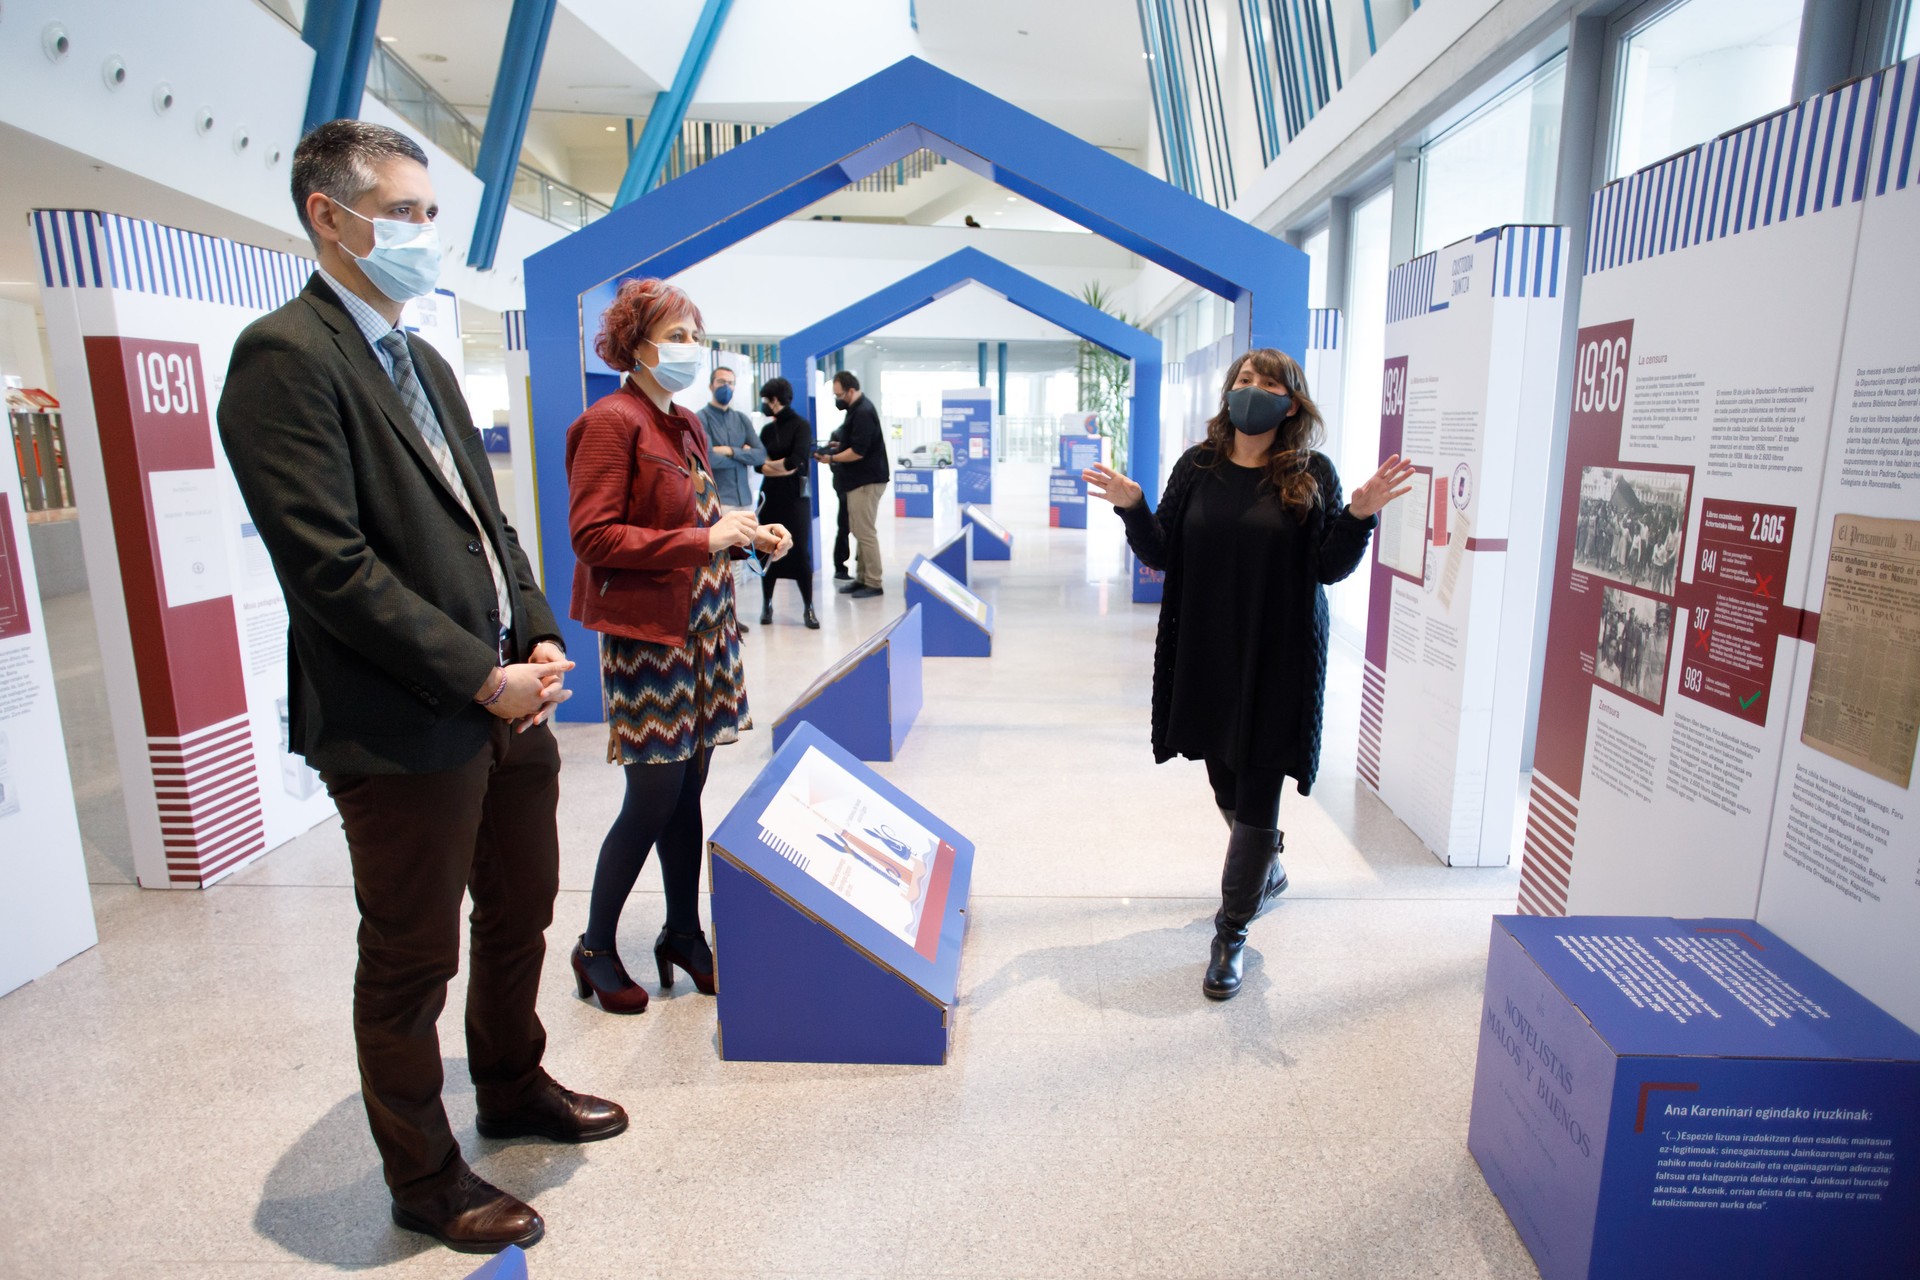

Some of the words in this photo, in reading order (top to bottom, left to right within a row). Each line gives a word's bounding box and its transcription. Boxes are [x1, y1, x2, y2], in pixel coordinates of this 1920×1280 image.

[1638, 356, 1644, 365] La
[1646, 355, 1667, 364] censura
[1575, 337, 1626, 412] 1936
[136, 352, 199, 414] 1931
[1860, 379, 1885, 387] Diputación
[1886, 377, 1907, 386] encargó
[1382, 366, 1404, 416] 1934
[1852, 400, 1857, 408] de
[1873, 399, 1896, 407] Biblioteca
[1892, 414, 1912, 423] bajaban
[1894, 424, 1917, 434] quedarse
[1862, 437, 1871, 445] baja
[1875, 448, 1899, 457] religiosas
[1842, 468, 1863, 476] biblioteca
[1865, 468, 1870, 476] de
[1879, 469, 1896, 478] Padres
[1841, 478, 1860, 487] Colegiata
[1862, 479, 1867, 487] de
[1706, 511, 1718, 519] Libros
[1750, 513, 1785, 544] 2.605
[1701, 549, 1717, 573] 841
[1831, 554, 1843, 562] Esta
[1845, 555, 1868, 567] mañana
[1880, 561, 1904, 574] declaró
[1906, 566, 1914, 575] el
[1845, 565, 1852, 573] de
[1855, 568, 1875, 578] guerra
[1879, 572, 1888, 580] en
[1890, 572, 1918, 586] Navarra
[1694, 607, 1709, 630] 317
[1684, 667, 1702, 692] 983
[1891, 808, 1903, 820] Foru
[1871, 823, 1889, 836] aurrera
[1505, 996, 1573, 1095] NOVELISTAS
[1487, 1007, 1521, 1066] MALOS
[1526, 1060, 1534, 1082] Y
[1537, 1077, 1591, 1158] BUENOS
[1664, 1104, 1687, 1116] Ana
[1691, 1105, 1752, 1117] Kareninari
[1756, 1107, 1810, 1120] egindako
[1813, 1109, 1872, 1120] iruzkinak:
[1715, 1133, 1740, 1141] lizuna
[1743, 1134, 1790, 1142] iradokitzen
[1792, 1135, 1813, 1143] duen
[1816, 1136, 1849, 1144] esaldia;
[1851, 1137, 1891, 1146] maitasun
[1721, 1147, 1789, 1156] sinesgaiztasuna
[1792, 1149, 1855, 1159] Jainkoarengan
[1858, 1151, 1871, 1159] eta
[1658, 1159, 1686, 1167] nahiko
[1714, 1160, 1765, 1169] iradokitzaile
[1783, 1163, 1847, 1172] engainagarrian
[1656, 1172, 1684, 1180] faltsua
[1702, 1173, 1748, 1183] kaltegarria
[1750, 1175, 1778, 1183] delako
[1781, 1176, 1808, 1184] ideian.
[1811, 1176, 1851, 1185] Jainkoari
[1853, 1179, 1888, 1187] buruzko
[1757, 1188, 1783, 1196] deista
[1816, 1191, 1843, 1199] aipatu
[1652, 1199, 1718, 1208] katolizismoaren
